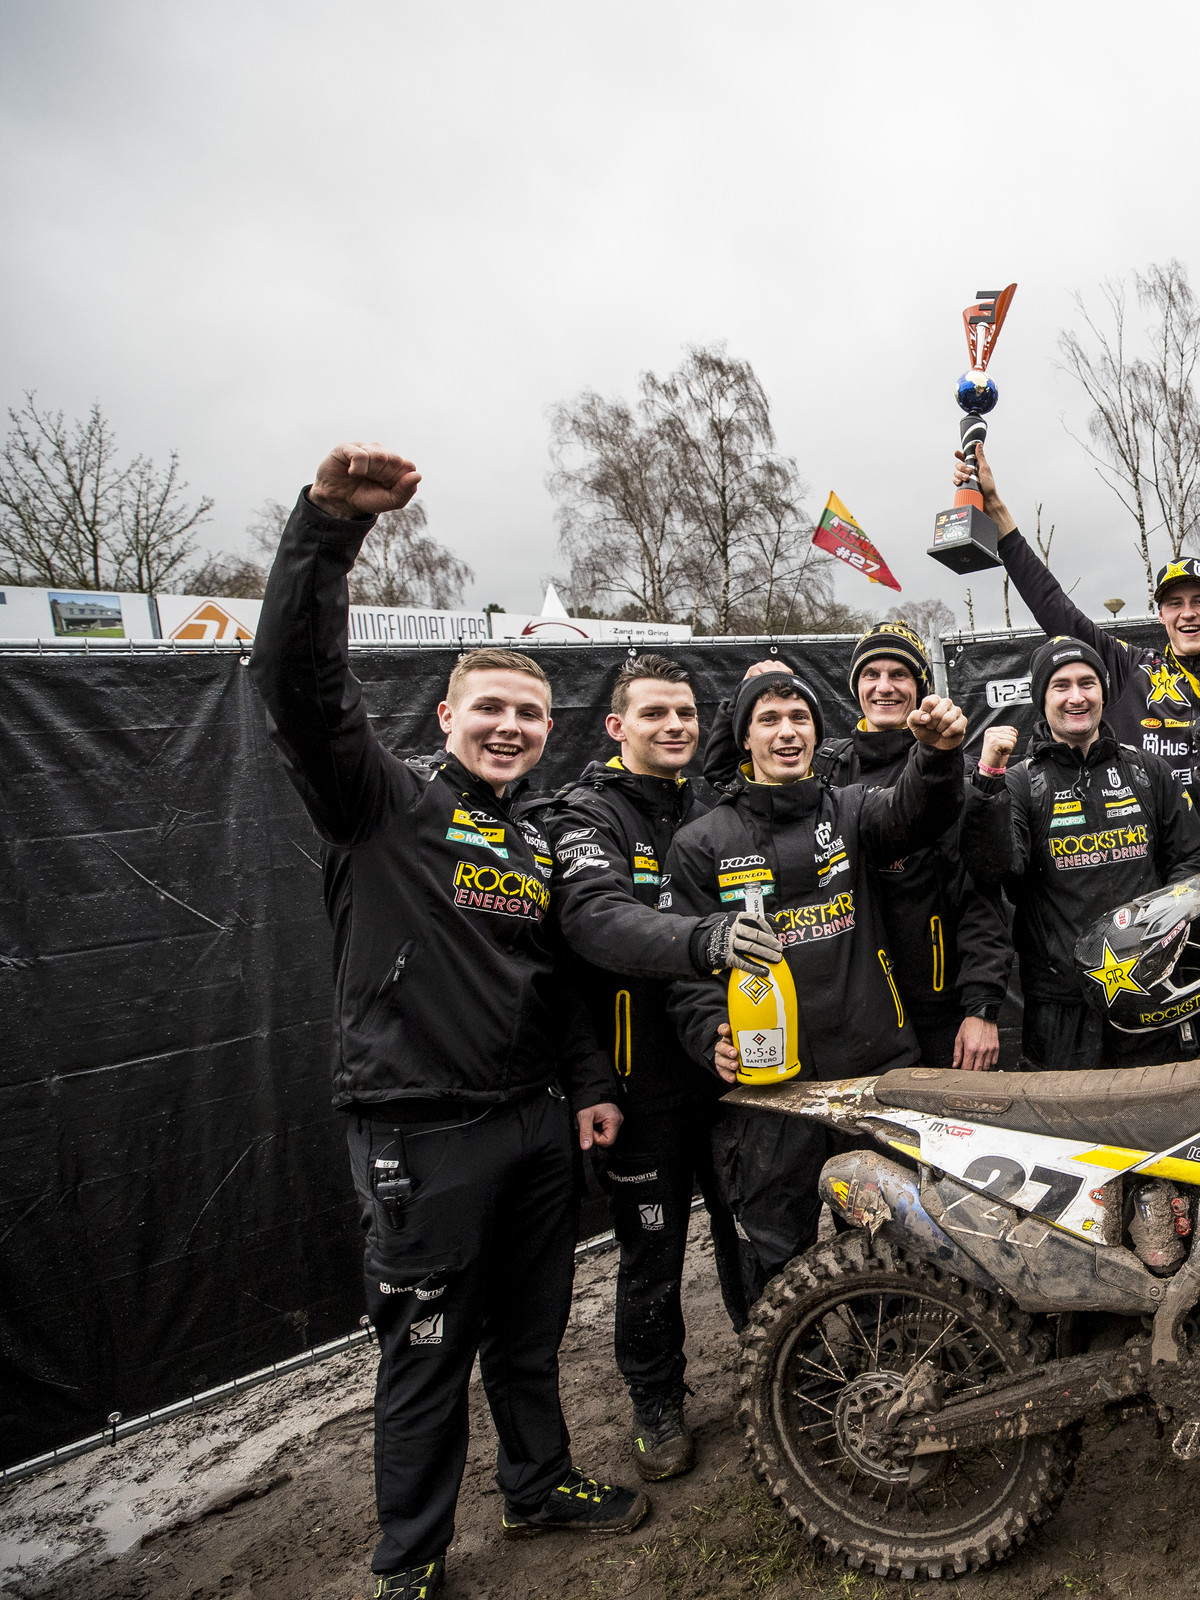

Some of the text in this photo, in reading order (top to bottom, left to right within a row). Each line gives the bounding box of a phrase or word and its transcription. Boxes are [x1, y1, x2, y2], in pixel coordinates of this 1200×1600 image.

[834, 546, 881, 573] #27
[613, 627, 633, 635] Zand
[720, 855, 766, 870] YOKO
[1056, 843, 1148, 868] ENERGY DRINK
[456, 889, 533, 914] ENERGY
[775, 893, 853, 931] CKSTAR
[777, 913, 855, 946] RGY DRINK
[929, 1121, 975, 1138] MXGP
[942, 1154, 1086, 1246] 27
